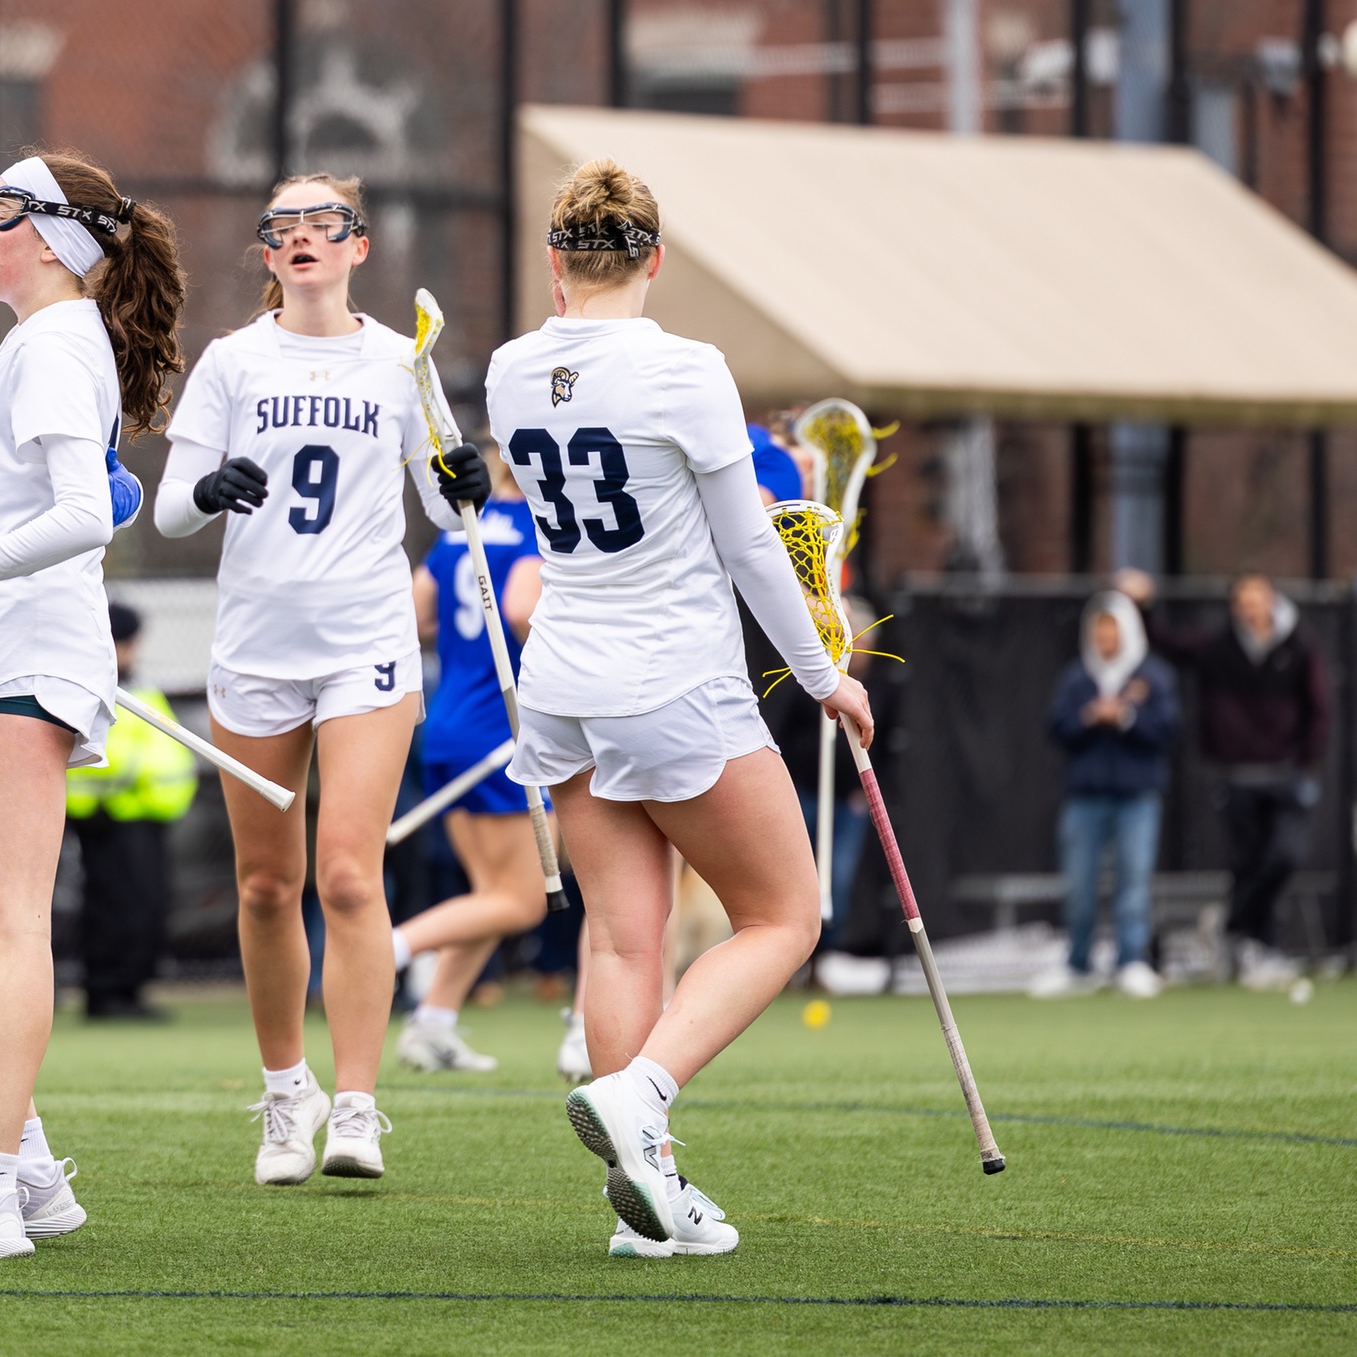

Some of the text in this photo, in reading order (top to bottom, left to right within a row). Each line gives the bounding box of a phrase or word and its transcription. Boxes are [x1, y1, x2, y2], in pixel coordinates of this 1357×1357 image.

[56, 205, 92, 220] STX
[577, 239, 615, 250] STX
[256, 395, 381, 438] SUFFOLK
[288, 445, 340, 535] 9
[508, 428, 645, 553] 33
[478, 575, 493, 611] GAIT
